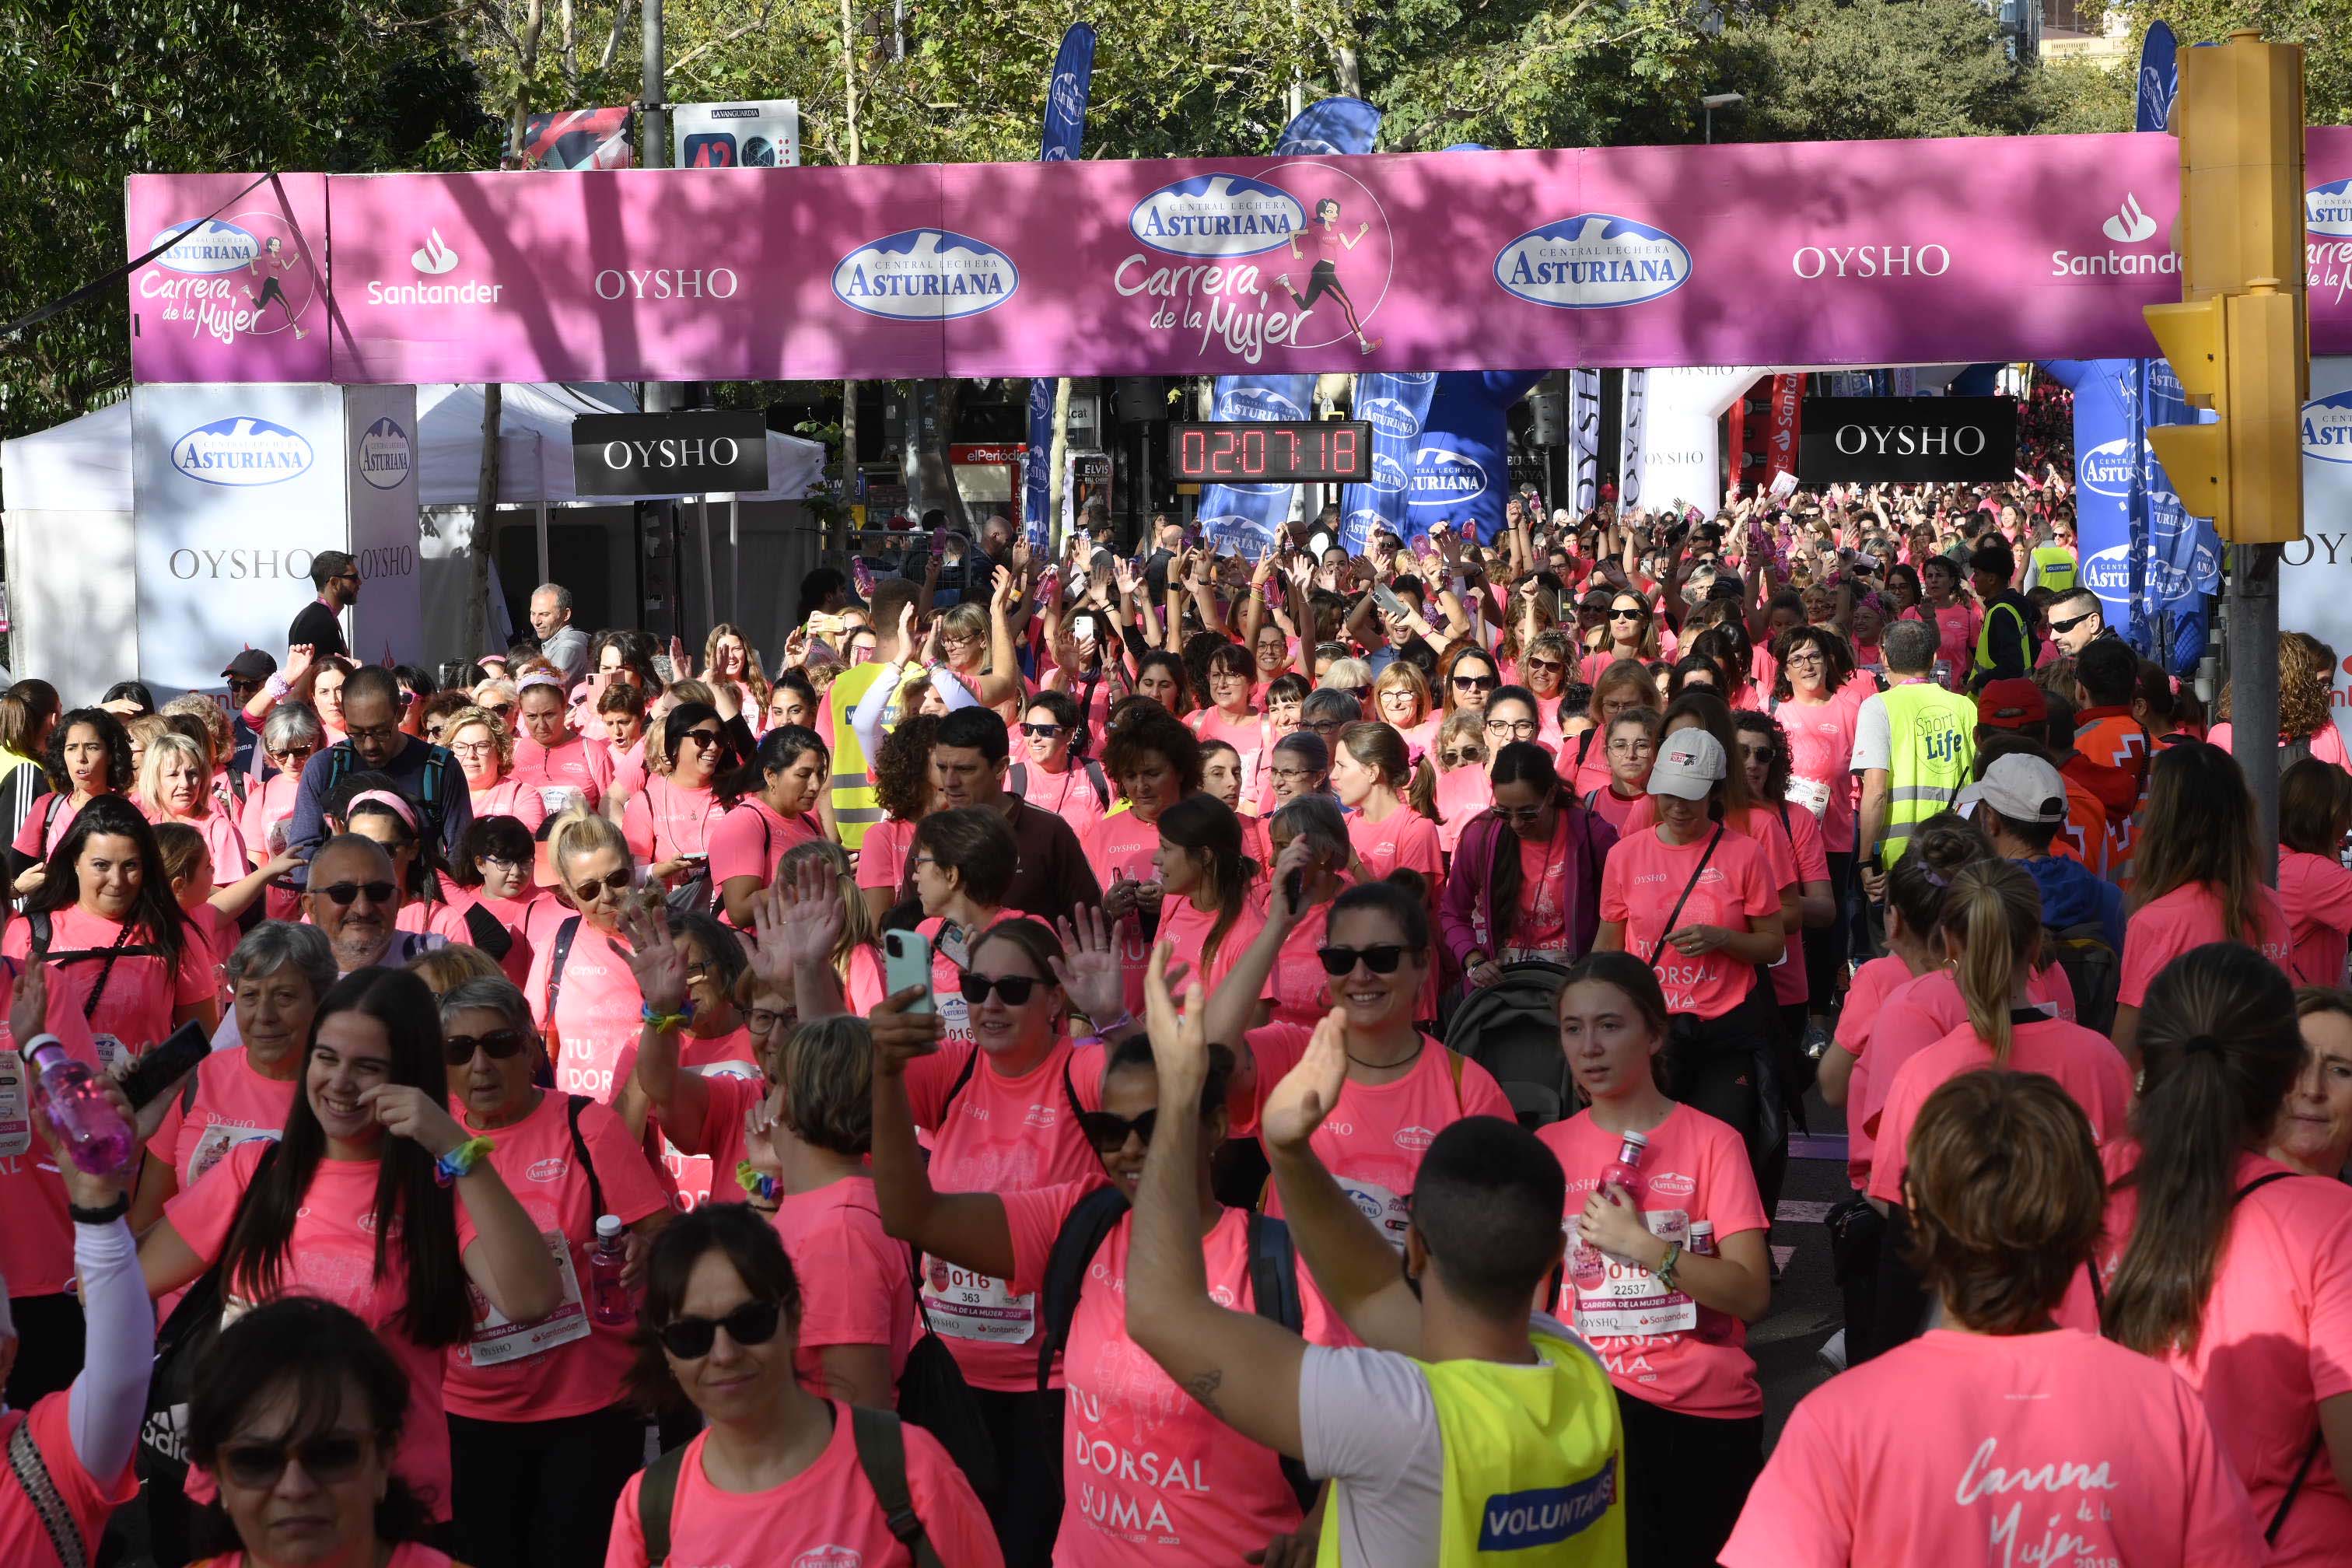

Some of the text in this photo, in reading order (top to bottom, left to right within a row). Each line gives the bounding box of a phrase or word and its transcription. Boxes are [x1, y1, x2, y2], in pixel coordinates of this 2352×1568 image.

[1169, 201, 1286, 212] CENTRAL LECHERA
[2306, 201, 2352, 222] ASTU
[1143, 205, 1291, 236] ASTURIANA
[1539, 245, 1670, 257] CENTRAL LECHERA
[1792, 243, 1951, 280] OYSHO
[2053, 250, 2182, 276] Santand
[874, 259, 998, 270] CENTRAL LECHERA
[1114, 254, 1259, 297] Carrera
[1509, 250, 1677, 285] ASTURIANA
[2324, 264, 2339, 286] la
[139, 269, 231, 299] Carrera
[595, 268, 738, 300] OYSHO
[846, 264, 1005, 297] ASTURIANA
[367, 281, 503, 305] Santander
[162, 296, 265, 345] de la Mujer
[1150, 291, 1314, 365] de la Mujer
[1222, 397, 1297, 422] ASTURIANA
[1364, 404, 1413, 434] ASTURIANA
[1181, 429, 1356, 474] 02:07:18
[1835, 424, 1986, 457] OYSHO
[183, 443, 303, 469] ASTURIANA
[362, 444, 408, 472] ASTURIANA
[604, 436, 739, 470] OYSHO
[1644, 450, 1704, 465] OYSHO
[1084, 464, 1108, 474] ELVIS
[361, 544, 411, 579] OYSHO
[2280, 533, 2352, 566] OY
[169, 548, 315, 579] OYSHO
[1916, 712, 1955, 737] Sport
[1925, 729, 1962, 762] Life
[1108, 844, 1141, 854] OYSHO
[1634, 873, 1668, 884] OYSHO
[1638, 940, 1658, 958] TU
[565, 1038, 593, 1060] TU
[569, 1068, 614, 1090] DOR
[206, 1111, 256, 1129] OYSHO
[961, 1101, 989, 1121] YSH
[1323, 1122, 1353, 1136] HO
[1397, 1133, 1433, 1146] ASTURIAN
[1652, 1180, 1694, 1191] ASTURIANA
[952, 1269, 990, 1289] 016
[1092, 1263, 1125, 1294] OSH
[1608, 1262, 1650, 1279] 016
[961, 1292, 981, 1304] 363
[1561, 1283, 1575, 1311] T
[1614, 1284, 1647, 1295] 22537
[959, 1306, 968, 1314] DE
[969, 1307, 978, 1316] LA
[978, 1309, 1003, 1318] MUJER
[1582, 1295, 1685, 1310] CARRERA DE LA MUJER 2023
[541, 1321, 579, 1340] Santander
[985, 1324, 1025, 1335] Santander
[1580, 1311, 1690, 1328] OYSHO Santander
[478, 1325, 508, 1340] ARRERA
[1068, 1381, 1101, 1423] TU
[1076, 1430, 1211, 1492] DORSAL
[1955, 1437, 2119, 1506] Carrera
[1081, 1480, 1174, 1534] SUMA
[1489, 1474, 1613, 1537] VOLUNTAS
[2077, 1497, 2095, 1521] de
[1158, 1535, 1180, 1545] 2023
[1990, 1500, 2098, 1568] Mujer
[2074, 1556, 2119, 1568] 2018
